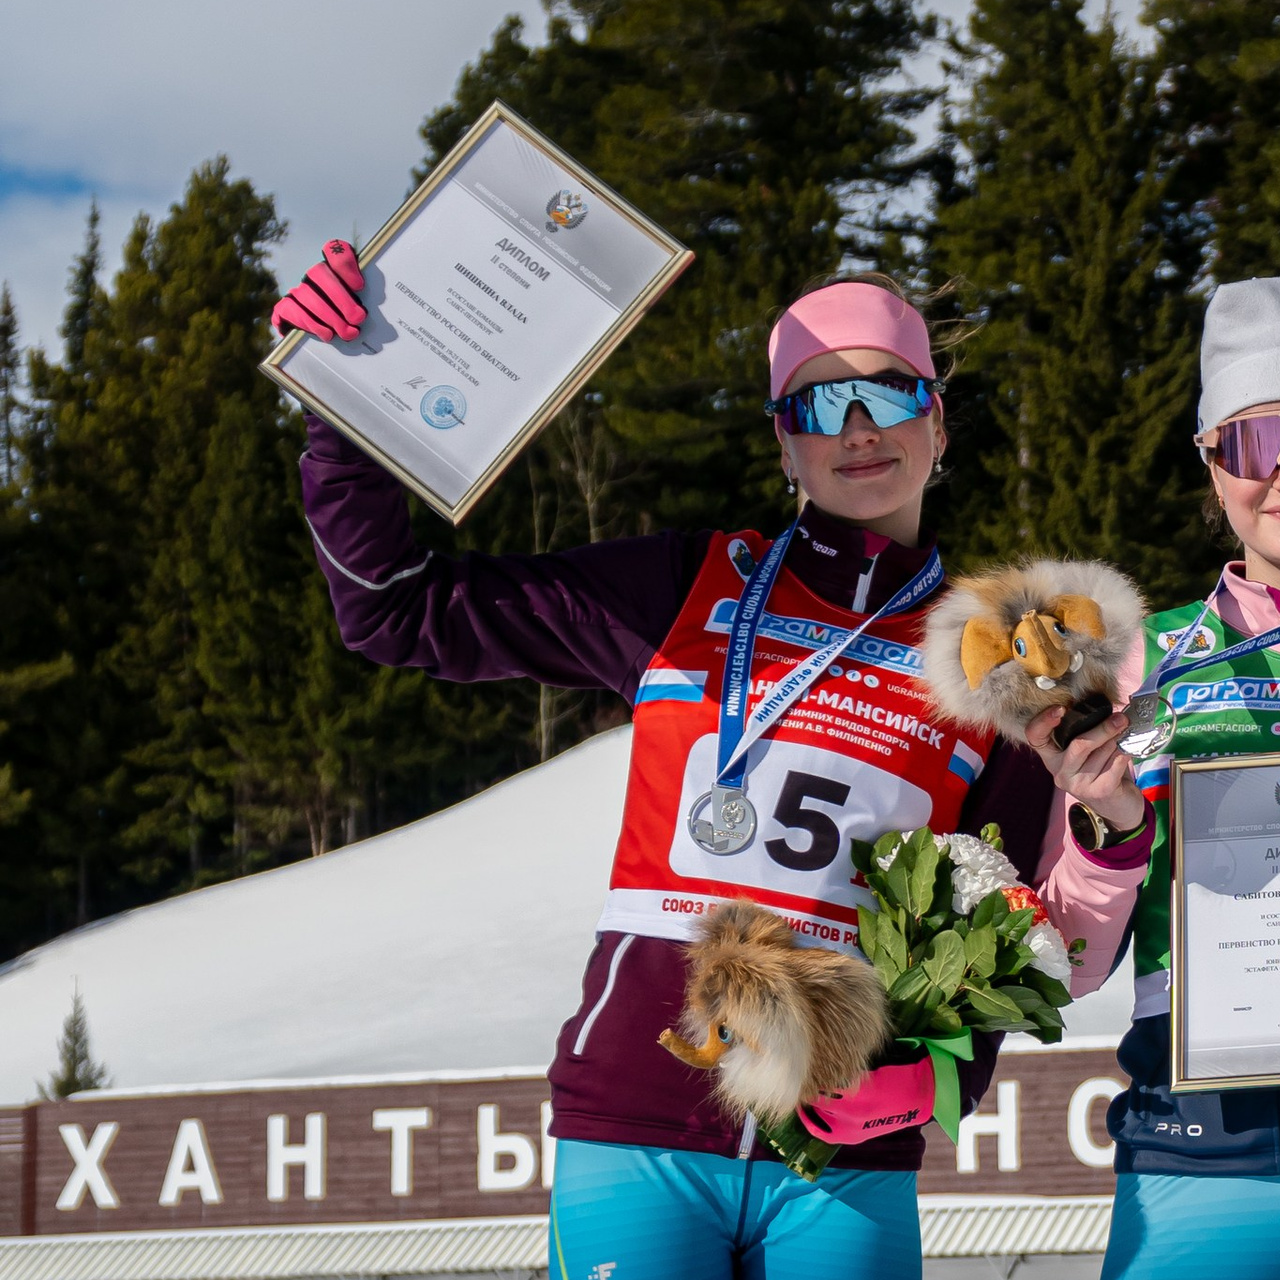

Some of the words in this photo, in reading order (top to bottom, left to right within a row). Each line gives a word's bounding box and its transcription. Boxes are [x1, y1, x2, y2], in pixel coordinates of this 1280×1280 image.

[495, 237, 551, 282] ДИПЛОМ
[498, 262, 531, 290] степени
[454, 262, 501, 302] ШИШКИНА
[499, 298, 528, 325] ВЛАДА
[394, 281, 442, 320] ПЕРВЕНСТВО
[440, 317, 473, 346] РОССИИ
[469, 340, 482, 353] ПО
[480, 349, 521, 382] БИАТЛОНУ
[754, 668, 812, 723] ФЕДЕРАЦИИ
[774, 719, 804, 730] МЕНИ
[805, 722, 825, 735] А.В.
[826, 727, 893, 757] ФИЛИПЕНКО
[787, 707, 833, 724] ЗИМНИХ
[834, 717, 871, 735] ВИДОВ
[871, 729, 910, 751] СПОРТА
[764, 770, 852, 872] 5
[662, 897, 704, 915] СОЮЗ
[1218, 938, 1276, 950] ПЕРВЕНСТВО
[1154, 1122, 1203, 1137] PRO
